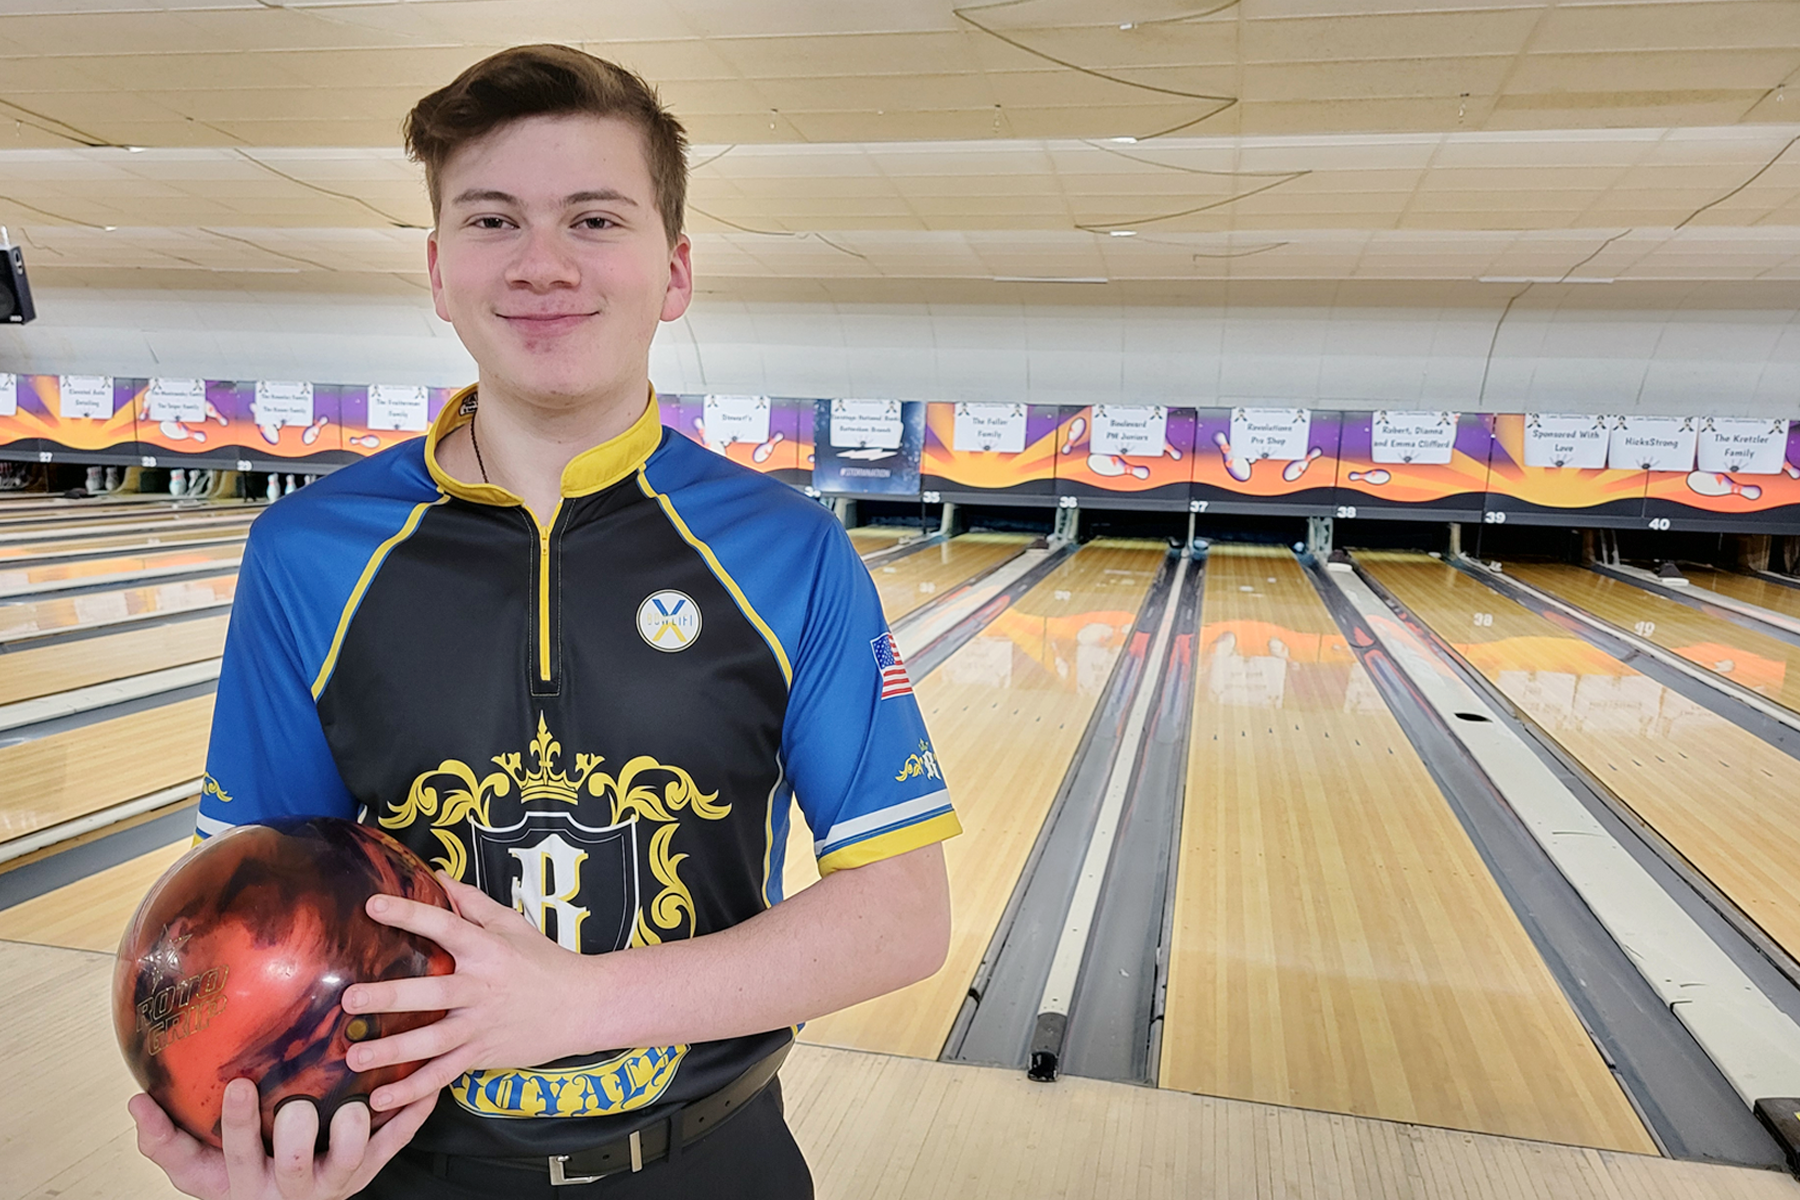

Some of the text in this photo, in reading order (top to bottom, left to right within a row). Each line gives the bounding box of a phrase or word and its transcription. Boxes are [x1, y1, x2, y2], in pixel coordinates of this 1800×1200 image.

[1532, 429, 1600, 439] Sponsored With
[1714, 433, 1730, 442] The
[1266, 436, 1286, 447] Shop
[1373, 439, 1388, 447] and
[1390, 439, 1416, 448] Emma
[1554, 443, 1574, 452] Love
[1724, 448, 1755, 459] Family
[1190, 500, 1209, 513] 37
[1336, 505, 1357, 518] 38
[1484, 511, 1506, 524] 39
[1648, 517, 1671, 531] 40
[135, 964, 230, 1033] ROTO
[147, 994, 228, 1056] GRIP
